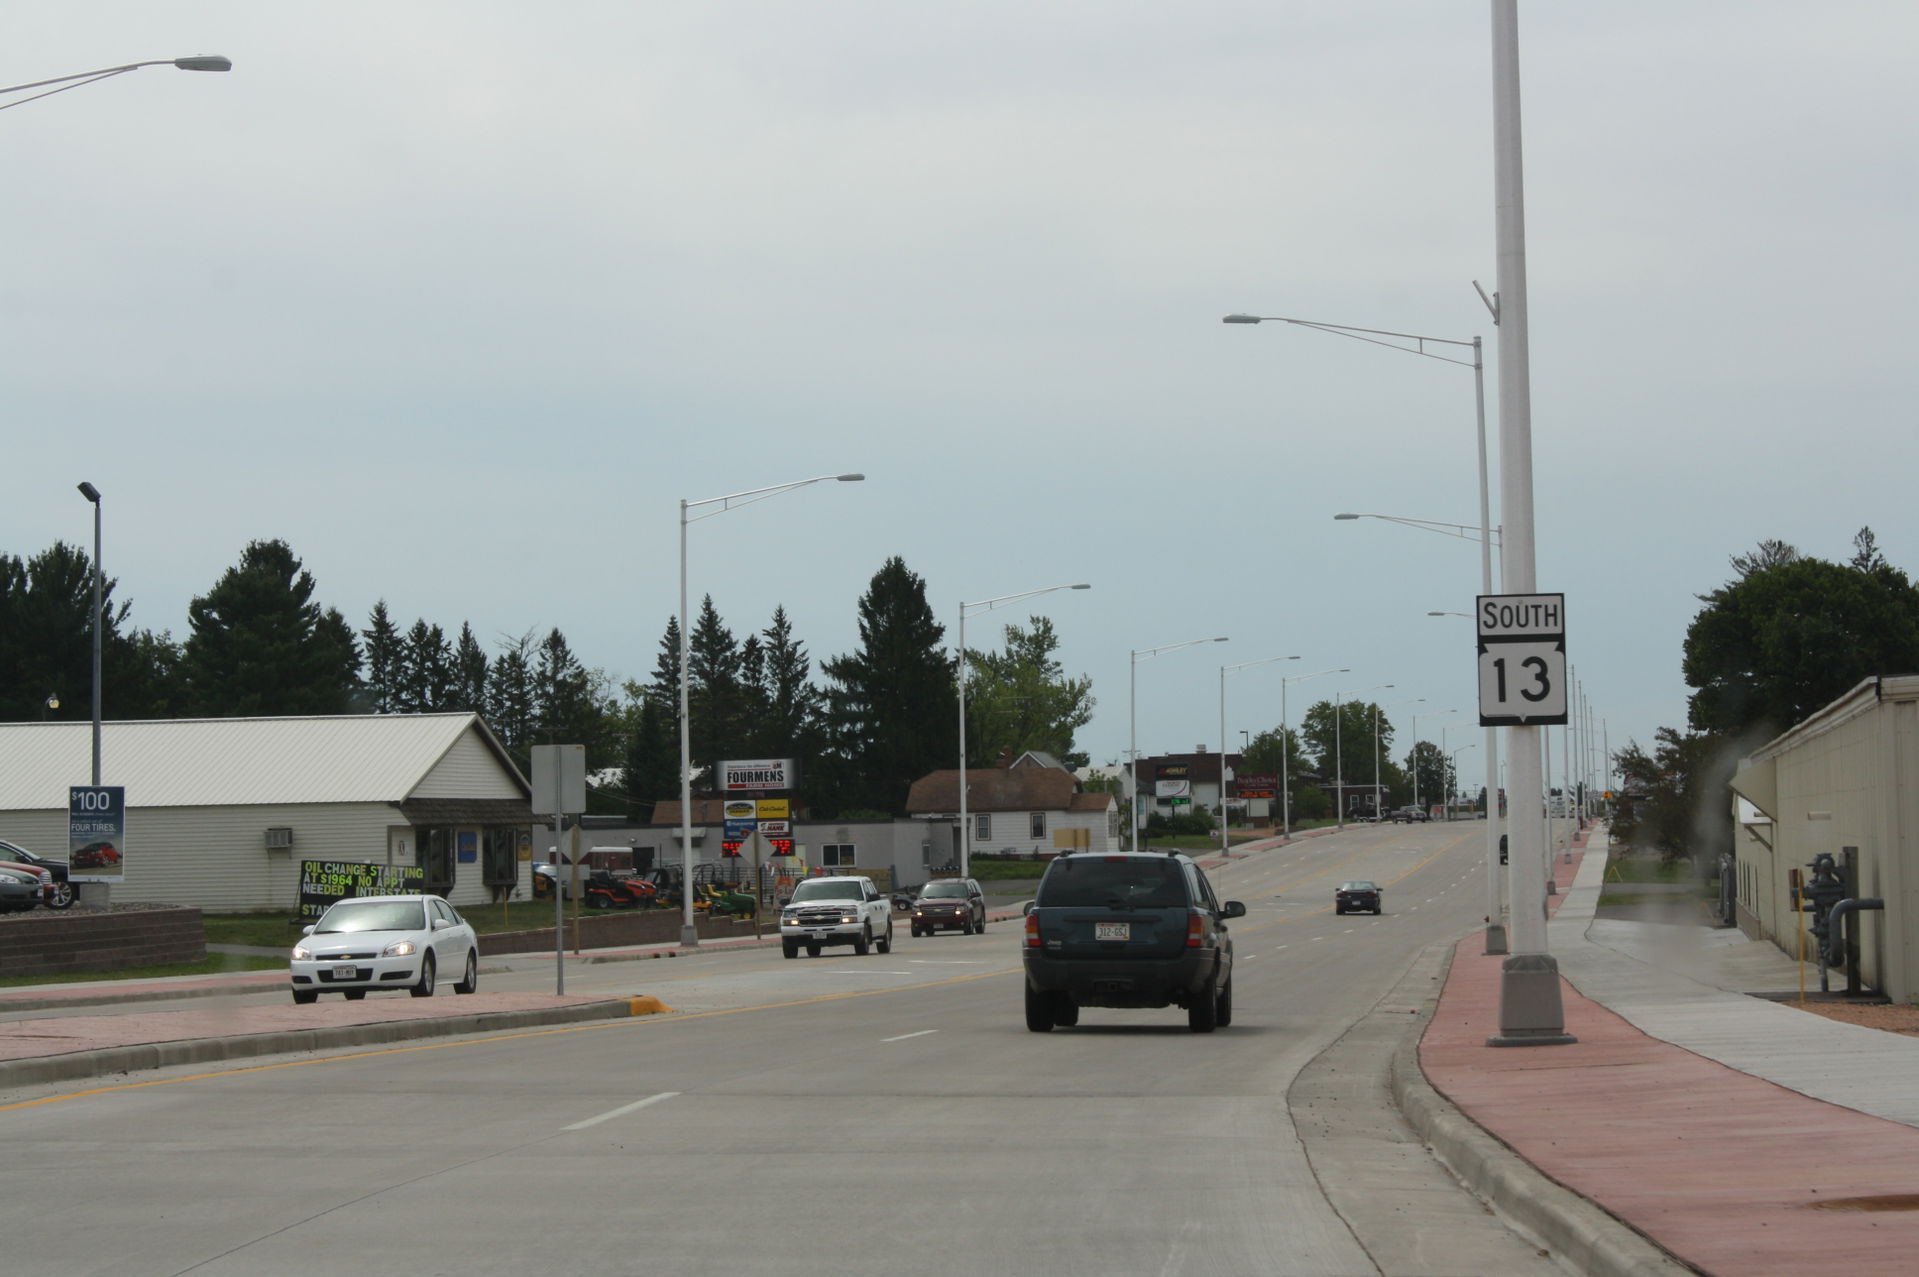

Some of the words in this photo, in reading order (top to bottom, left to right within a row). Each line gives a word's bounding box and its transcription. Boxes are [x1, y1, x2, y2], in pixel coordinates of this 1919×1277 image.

[1483, 601, 1558, 629] SOUTH
[1493, 655, 1551, 703] 13
[727, 770, 784, 783] FOURMENS
[71, 791, 110, 810] $100
[71, 823, 91, 831] FOUR
[305, 861, 323, 874] OIL
[325, 862, 366, 876] CHANGE
[370, 865, 424, 879] STARTING
[304, 872, 319, 883] AT
[358, 876, 372, 887] NO
[376, 878, 405, 889] APPT
[302, 883, 345, 896] NEEDED
